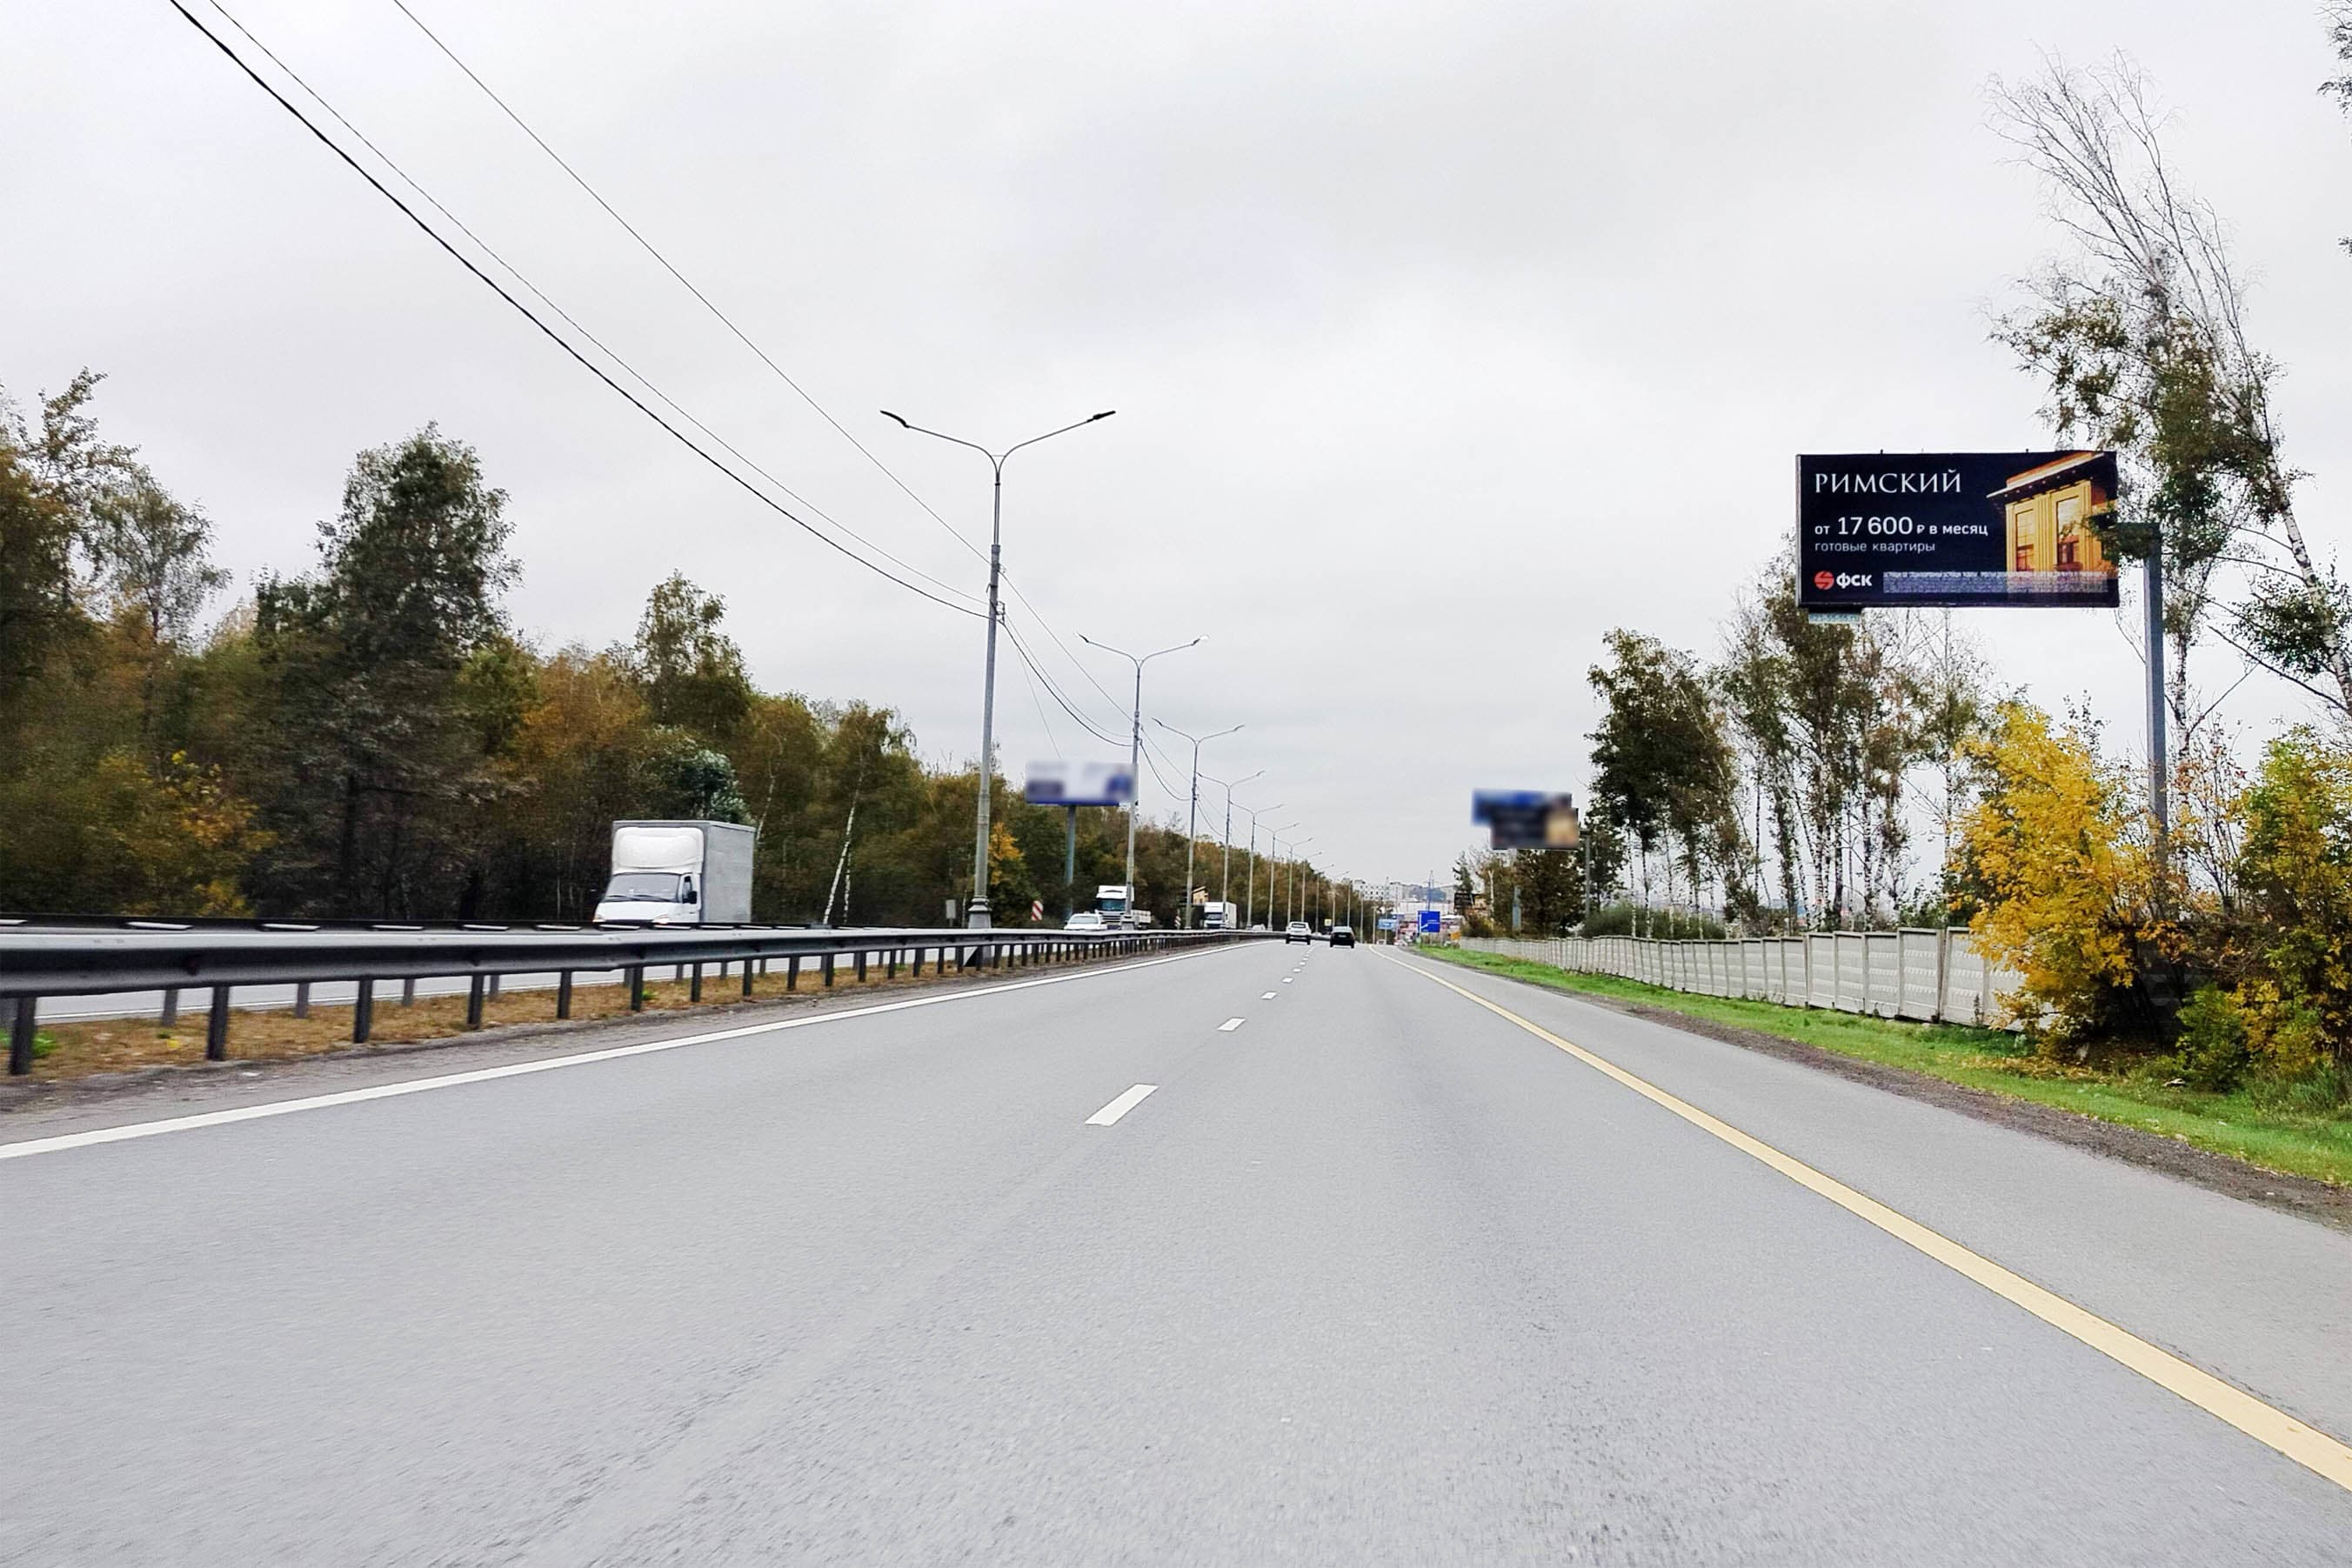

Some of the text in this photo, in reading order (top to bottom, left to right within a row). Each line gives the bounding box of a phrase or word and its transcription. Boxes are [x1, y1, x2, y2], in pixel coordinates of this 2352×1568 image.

[1814, 468, 1961, 494] РИМСКИЙ
[1814, 524, 1831, 535] от
[1929, 525, 1938, 535] в
[1942, 524, 1988, 537] месяц
[1814, 542, 1935, 554] готовые квартиры
[1835, 572, 1873, 589] ФСК
